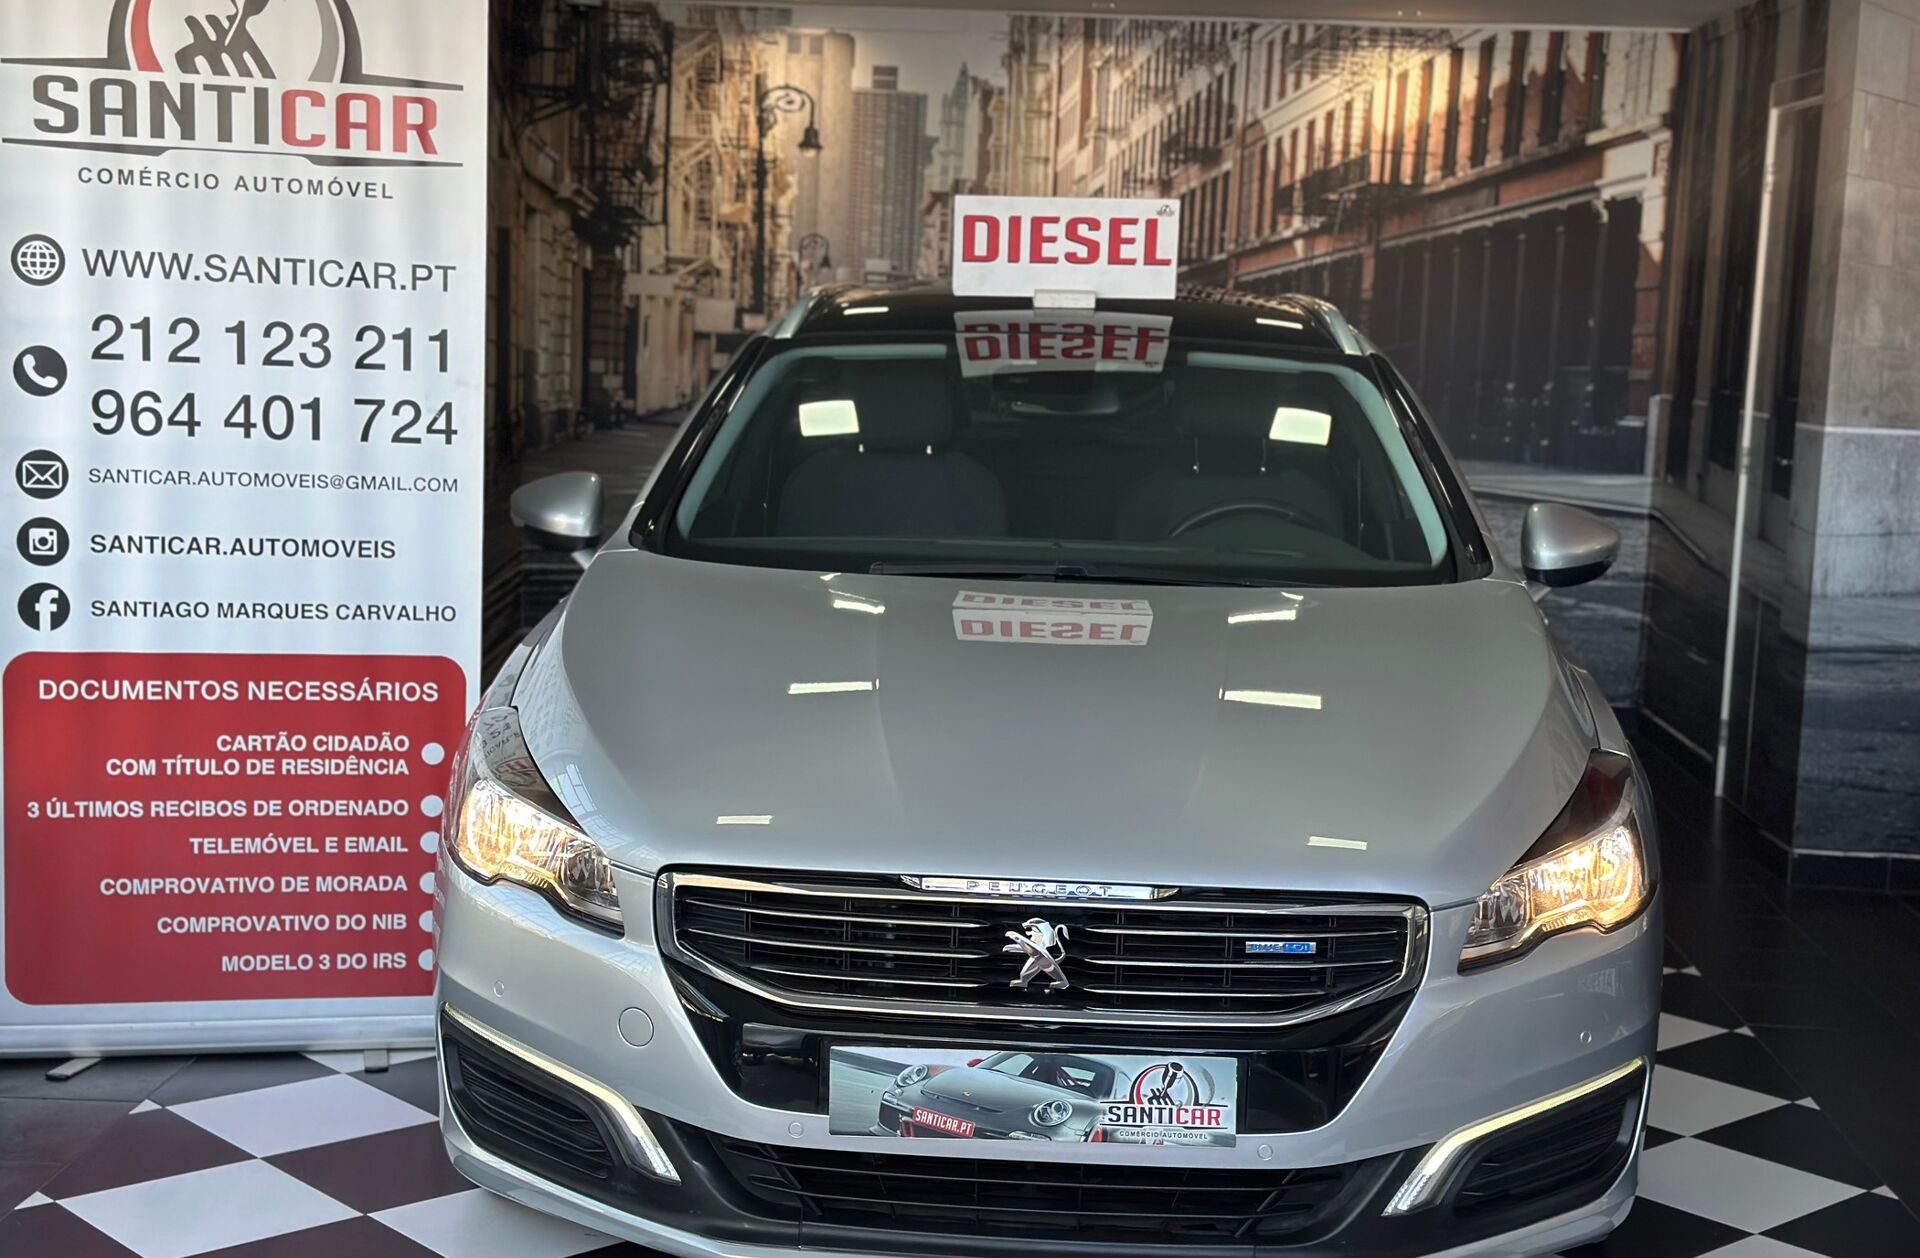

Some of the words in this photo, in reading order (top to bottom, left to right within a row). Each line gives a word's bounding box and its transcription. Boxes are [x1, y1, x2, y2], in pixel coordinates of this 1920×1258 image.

[32, 74, 438, 155] SANTICAR
[77, 166, 220, 190] COMÉRCIO
[234, 175, 394, 200] AUTOMÓVEL
[962, 214, 1172, 266] DIESEL
[81, 248, 457, 293] WWW.SANTICAR.PT
[90, 313, 201, 364] 212
[224, 320, 332, 369] 123
[354, 324, 448, 373] 211
[91, 388, 202, 438] 964
[223, 394, 321, 441] 401
[354, 398, 458, 445] 724
[88, 467, 458, 493] SANTICAR.AUTOMOVEIS@GMAIL.COM
[90, 534, 396, 559] SANTICAR.AUTOMOVEIS
[91, 599, 210, 619] SANTIAGO
[217, 602, 329, 620] MARQUES
[335, 603, 457, 622] CARVALHO
[39, 679, 239, 701] DOCUMENTOS
[248, 676, 439, 702] NECESSÁRIOS
[216, 731, 307, 752] CARTÃO
[312, 731, 410, 752] CIDADÃO
[106, 758, 156, 776] COM
[161, 753, 240, 776] TÍTULO
[246, 758, 276, 775] DE
[281, 753, 409, 775] RESIDÊNCIA
[27, 801, 40, 819] 3
[46, 797, 144, 819] ÚLTIMOS
[150, 799, 247, 818] RECIBOS
[253, 799, 283, 817] DE
[288, 799, 409, 817] ORDENADO
[188, 832, 320, 855] TELEMÓVEL
[325, 836, 339, 853] E
[344, 836, 409, 853] EMAIL
[100, 876, 275, 896] COMPROVATIVO
[281, 876, 310, 893] DE
[315, 875, 408, 893] MORADA
[966, 880, 1113, 897] PEUGEOT
[157, 914, 330, 934] COMPROVATIVO
[335, 913, 367, 931] DO
[372, 913, 407, 930] NIB
[221, 953, 314, 972] MODELO
[318, 953, 331, 970] 3
[336, 952, 368, 970] DO
[373, 952, 407, 969] IRS
[915, 1109, 972, 1135] SANTICAR.PT
[1108, 1105, 1221, 1126] SANTICAR
